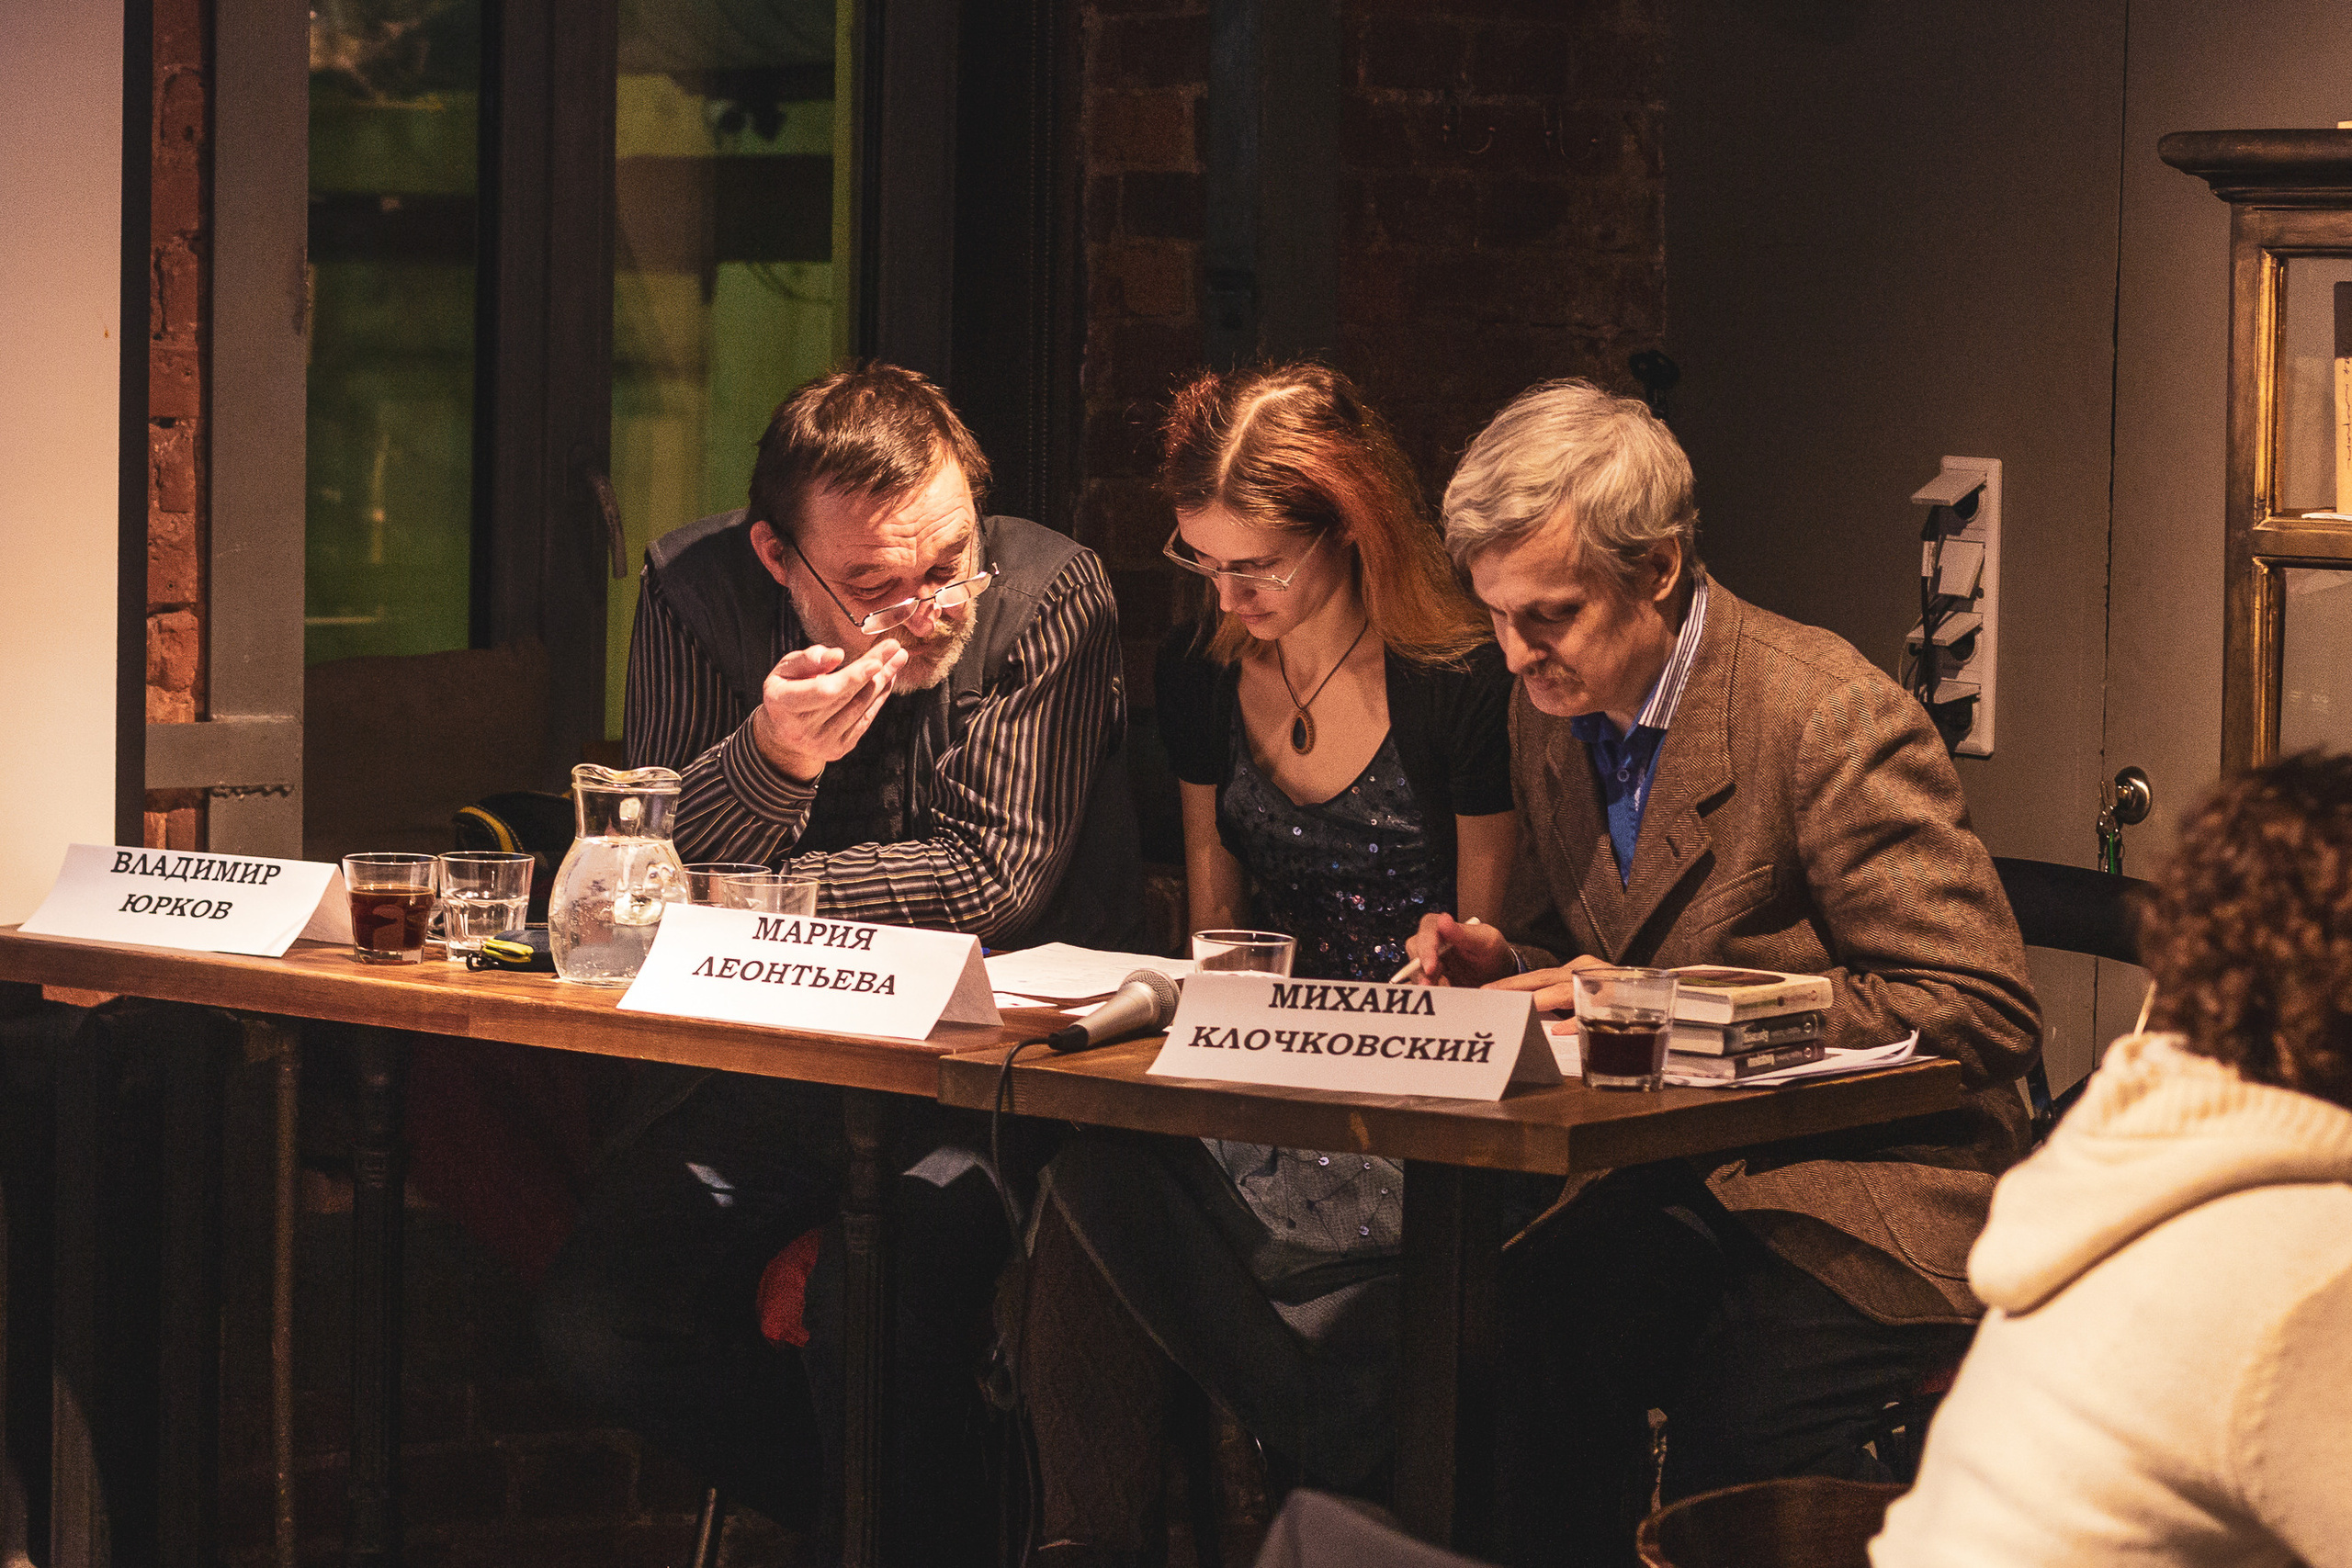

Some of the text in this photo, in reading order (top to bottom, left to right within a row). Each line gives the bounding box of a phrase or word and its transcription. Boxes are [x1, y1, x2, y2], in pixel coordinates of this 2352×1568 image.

[110, 851, 282, 886] ВЛАДИМИР
[119, 893, 234, 920] ЮРКОВ
[752, 917, 878, 952] МАРИЯ
[692, 956, 896, 996] ЛЕОНТЬЕВА
[1268, 982, 1437, 1016] МИХАИЛ
[1187, 1026, 1496, 1064] КЛОЧКОВСКИЙ
